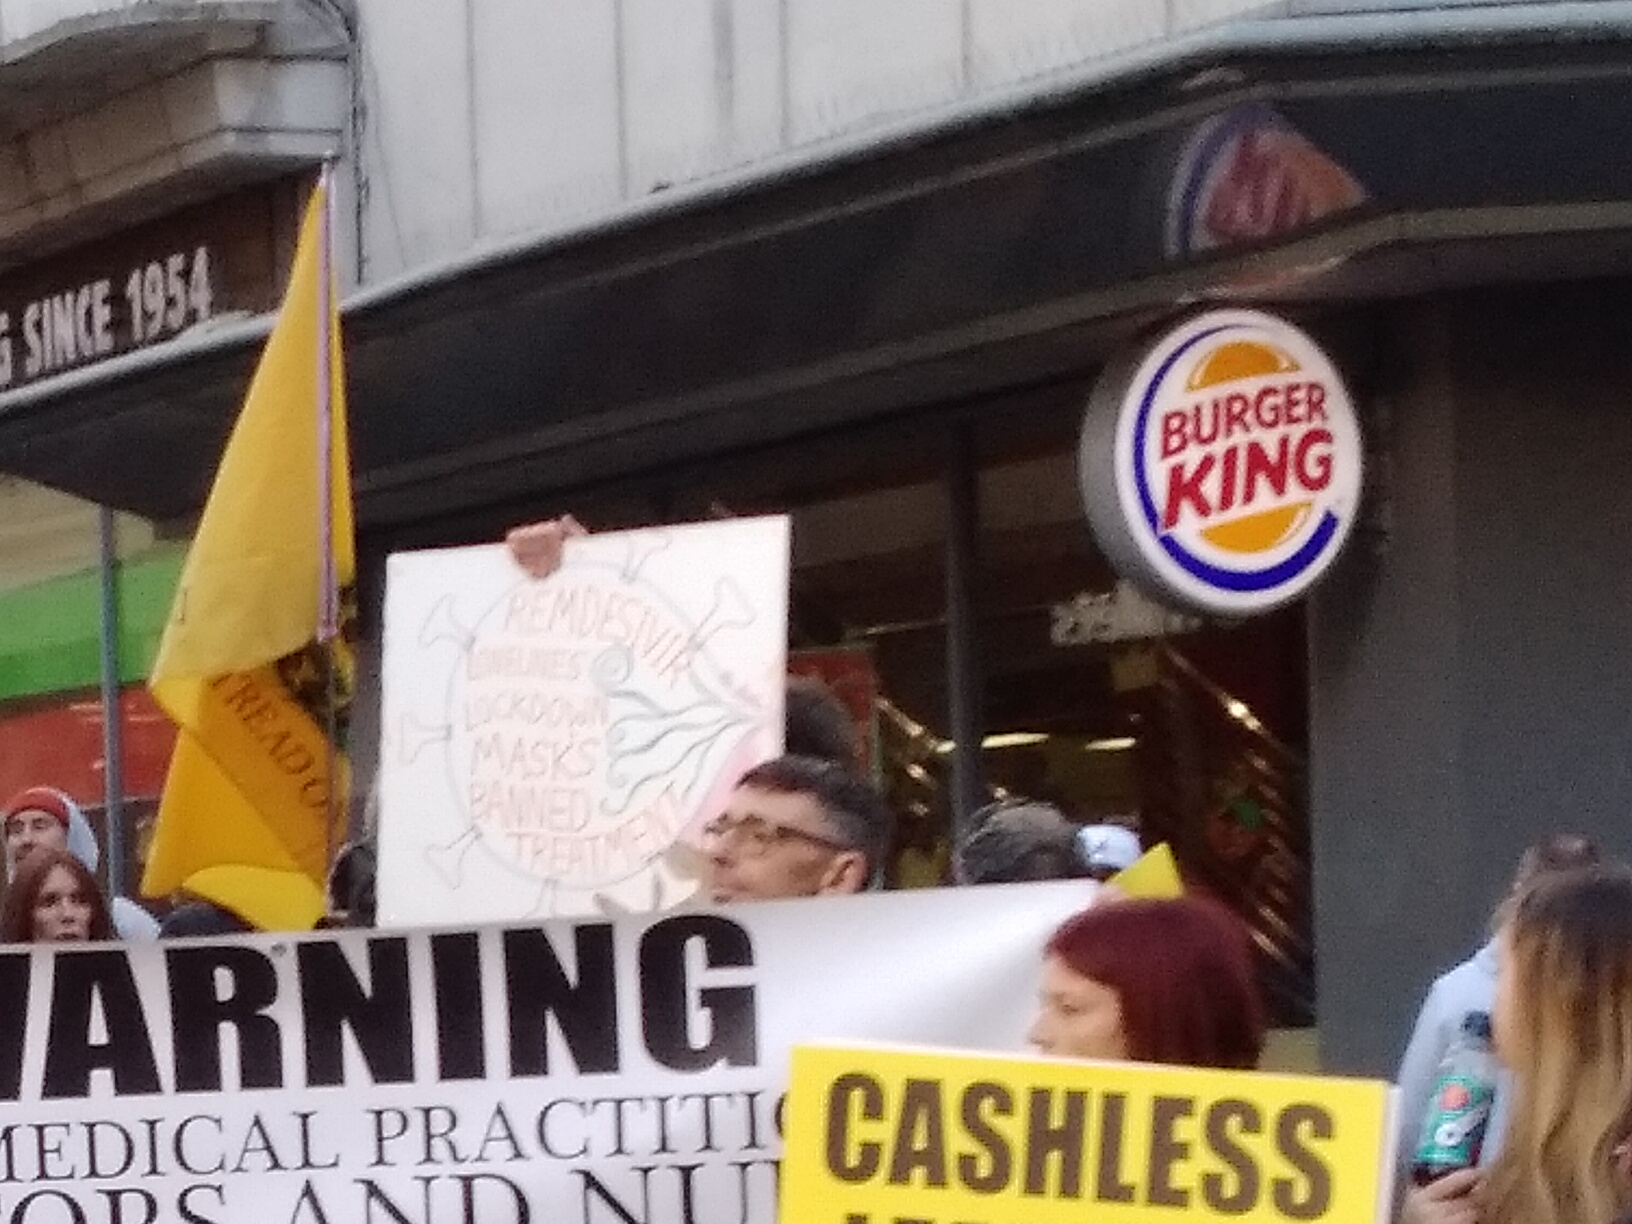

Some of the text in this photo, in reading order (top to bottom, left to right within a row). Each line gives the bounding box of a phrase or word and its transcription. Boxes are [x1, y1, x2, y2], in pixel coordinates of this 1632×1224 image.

[23, 280, 113, 376] SINCE
[125, 246, 213, 343] 1954
[1161, 382, 1329, 460] BURGER
[1163, 428, 1333, 530] KING
[469, 732, 601, 782] MASKS
[469, 778, 592, 833] BANNED
[824, 1071, 1336, 1222] CASHLESS
